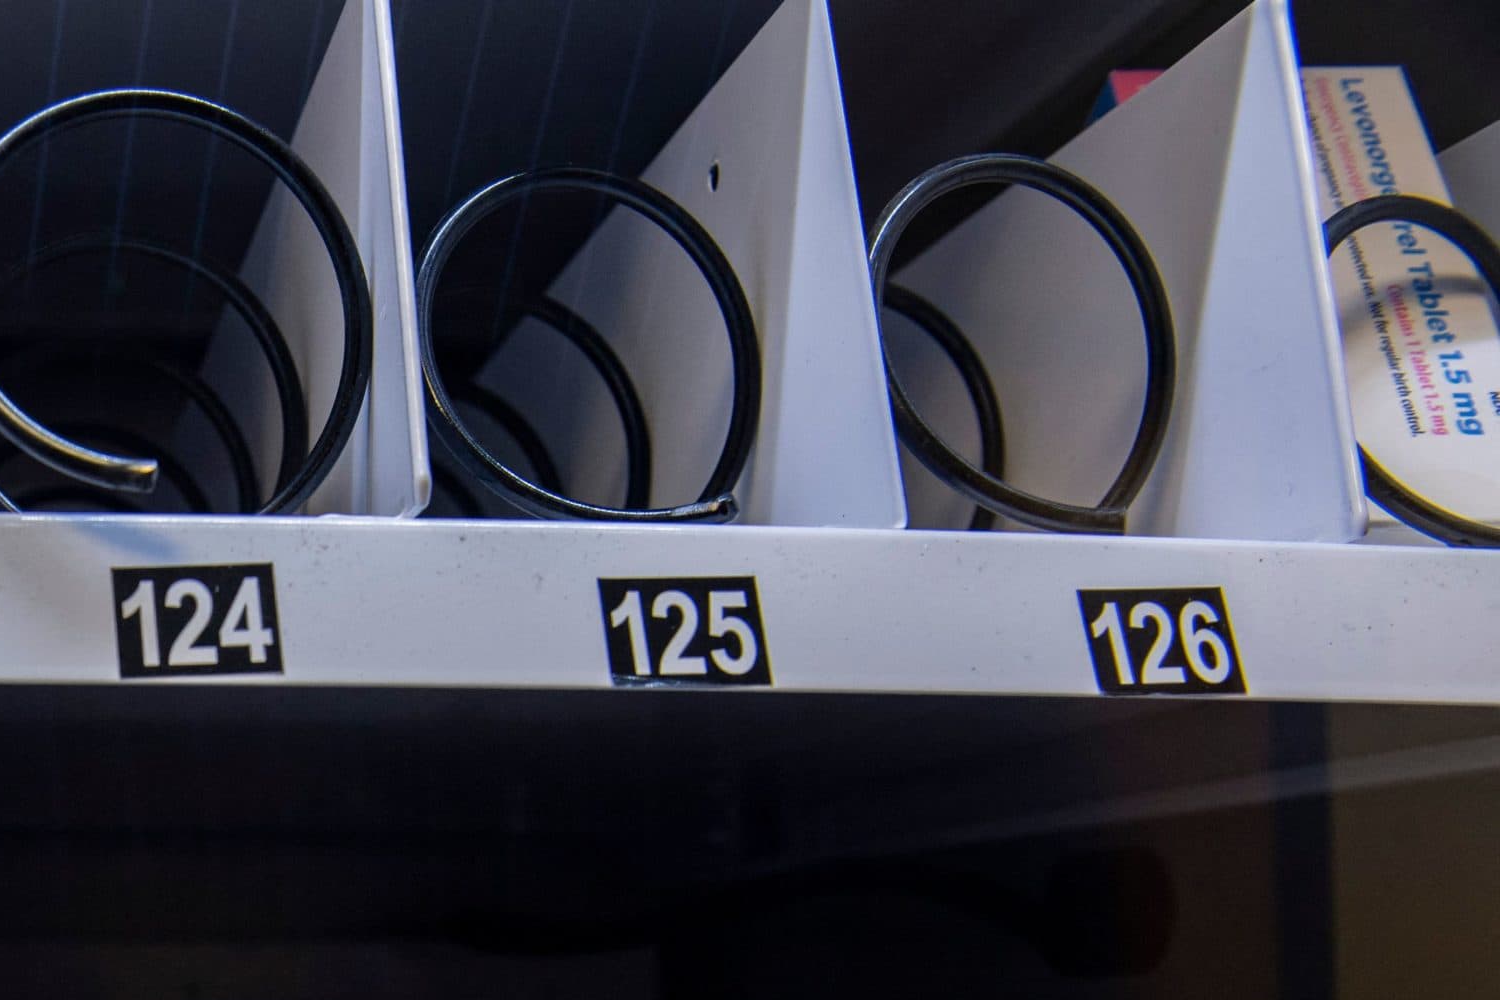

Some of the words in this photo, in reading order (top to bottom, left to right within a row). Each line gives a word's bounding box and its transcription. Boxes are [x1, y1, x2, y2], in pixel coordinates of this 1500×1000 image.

[1387, 284, 1414, 337] Contains
[1408, 262, 1455, 343] Tablet
[1409, 350, 1435, 389] Tablet
[1439, 350, 1472, 384] 1.5
[1424, 393, 1445, 412] 1.5
[1430, 415, 1450, 436] mg
[1451, 392, 1485, 436] mg
[121, 576, 273, 668] 124
[610, 590, 758, 676] 125
[1091, 600, 1232, 685] 126
